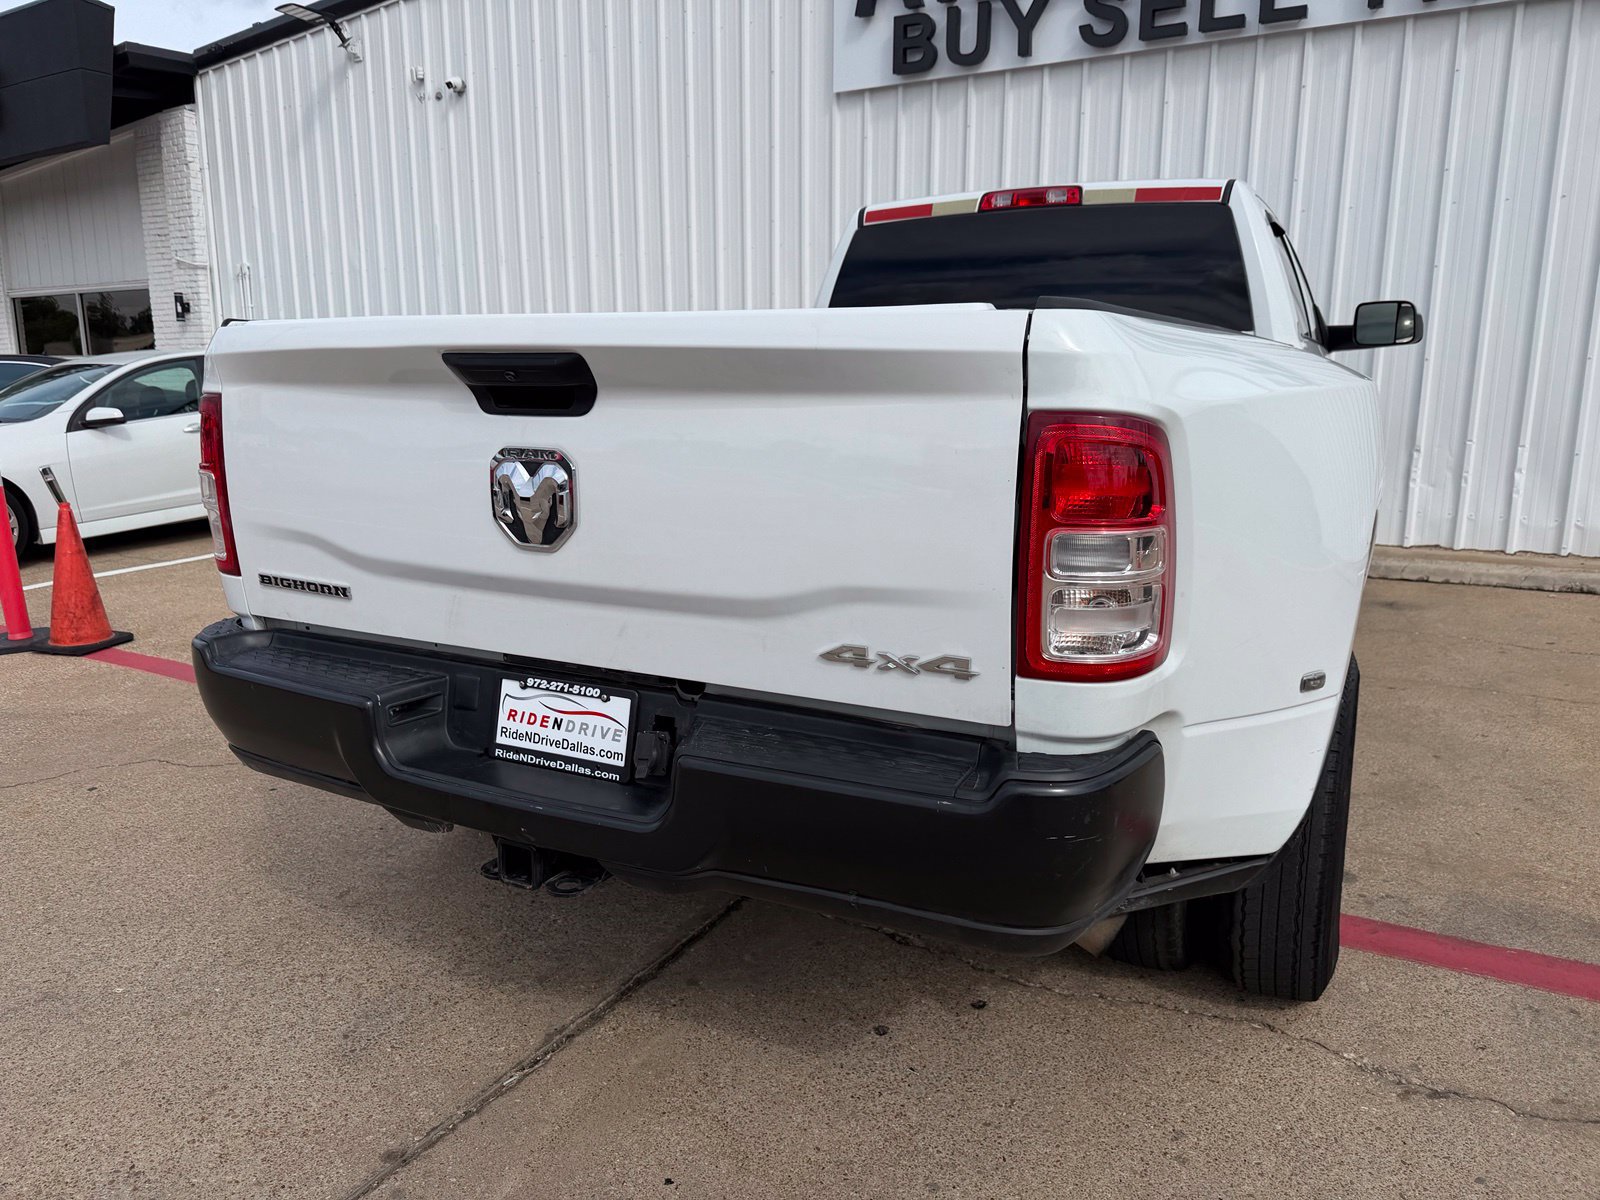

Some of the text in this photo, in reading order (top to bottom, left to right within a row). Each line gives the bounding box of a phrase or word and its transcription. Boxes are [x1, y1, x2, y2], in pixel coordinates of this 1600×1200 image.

[893, 0, 1049, 75] BUY
[504, 448, 558, 460] RAM
[258, 573, 352, 600] BIGHORN
[526, 677, 601, 698] 972-271-5100
[500, 726, 624, 762] RideNDriveDallas.com
[494, 748, 620, 781] RideNDriveDallas.com
